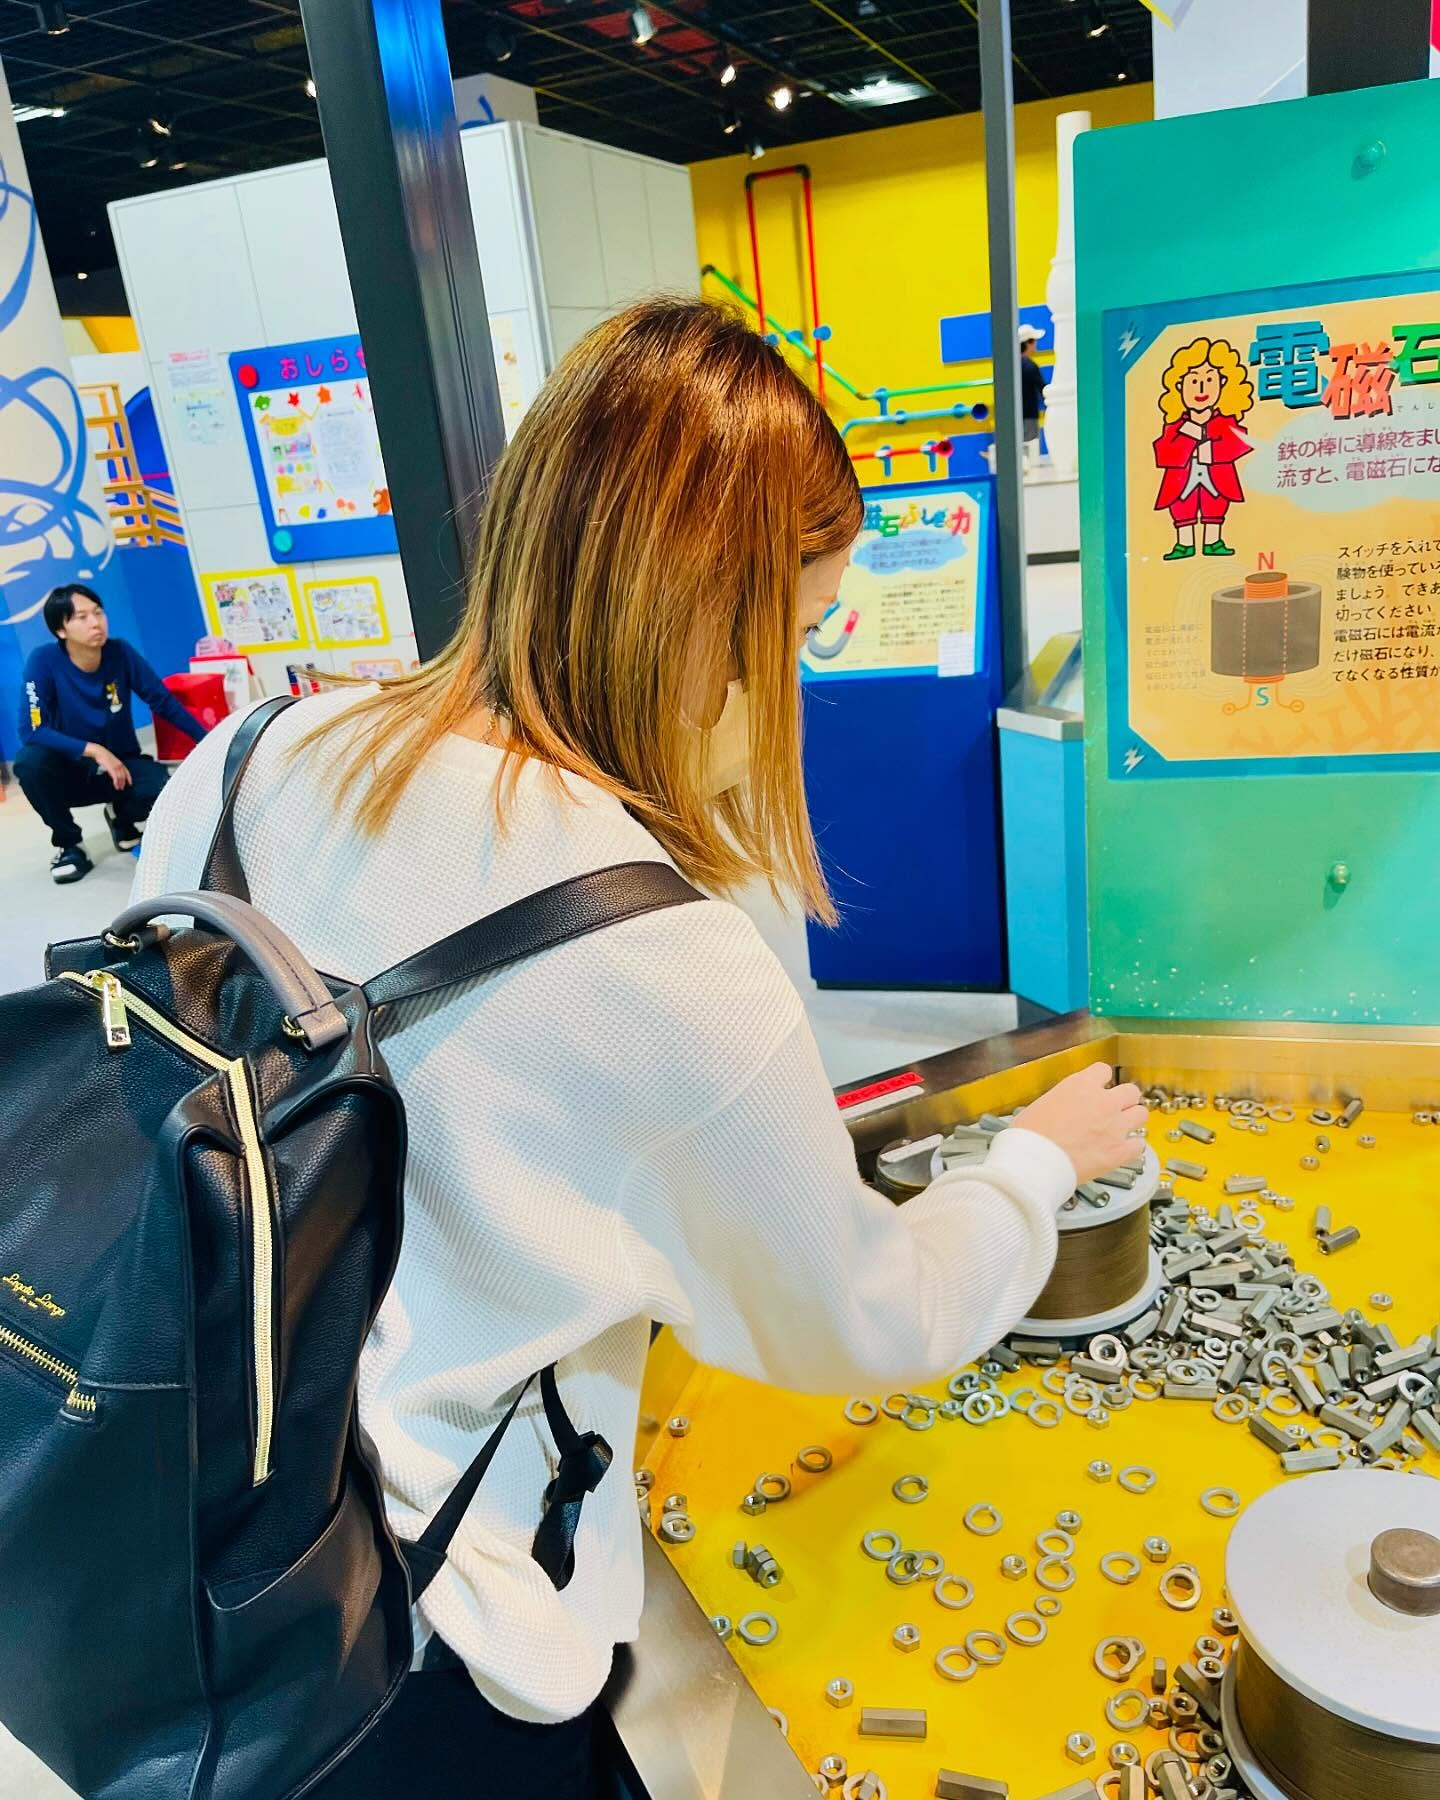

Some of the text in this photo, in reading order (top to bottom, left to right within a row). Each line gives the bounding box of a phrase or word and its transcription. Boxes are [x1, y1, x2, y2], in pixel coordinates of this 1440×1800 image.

[1257, 552, 1275, 571] N
[1333, 623, 1440, 643] 電磁石には電流
[1256, 687, 1270, 706] S
